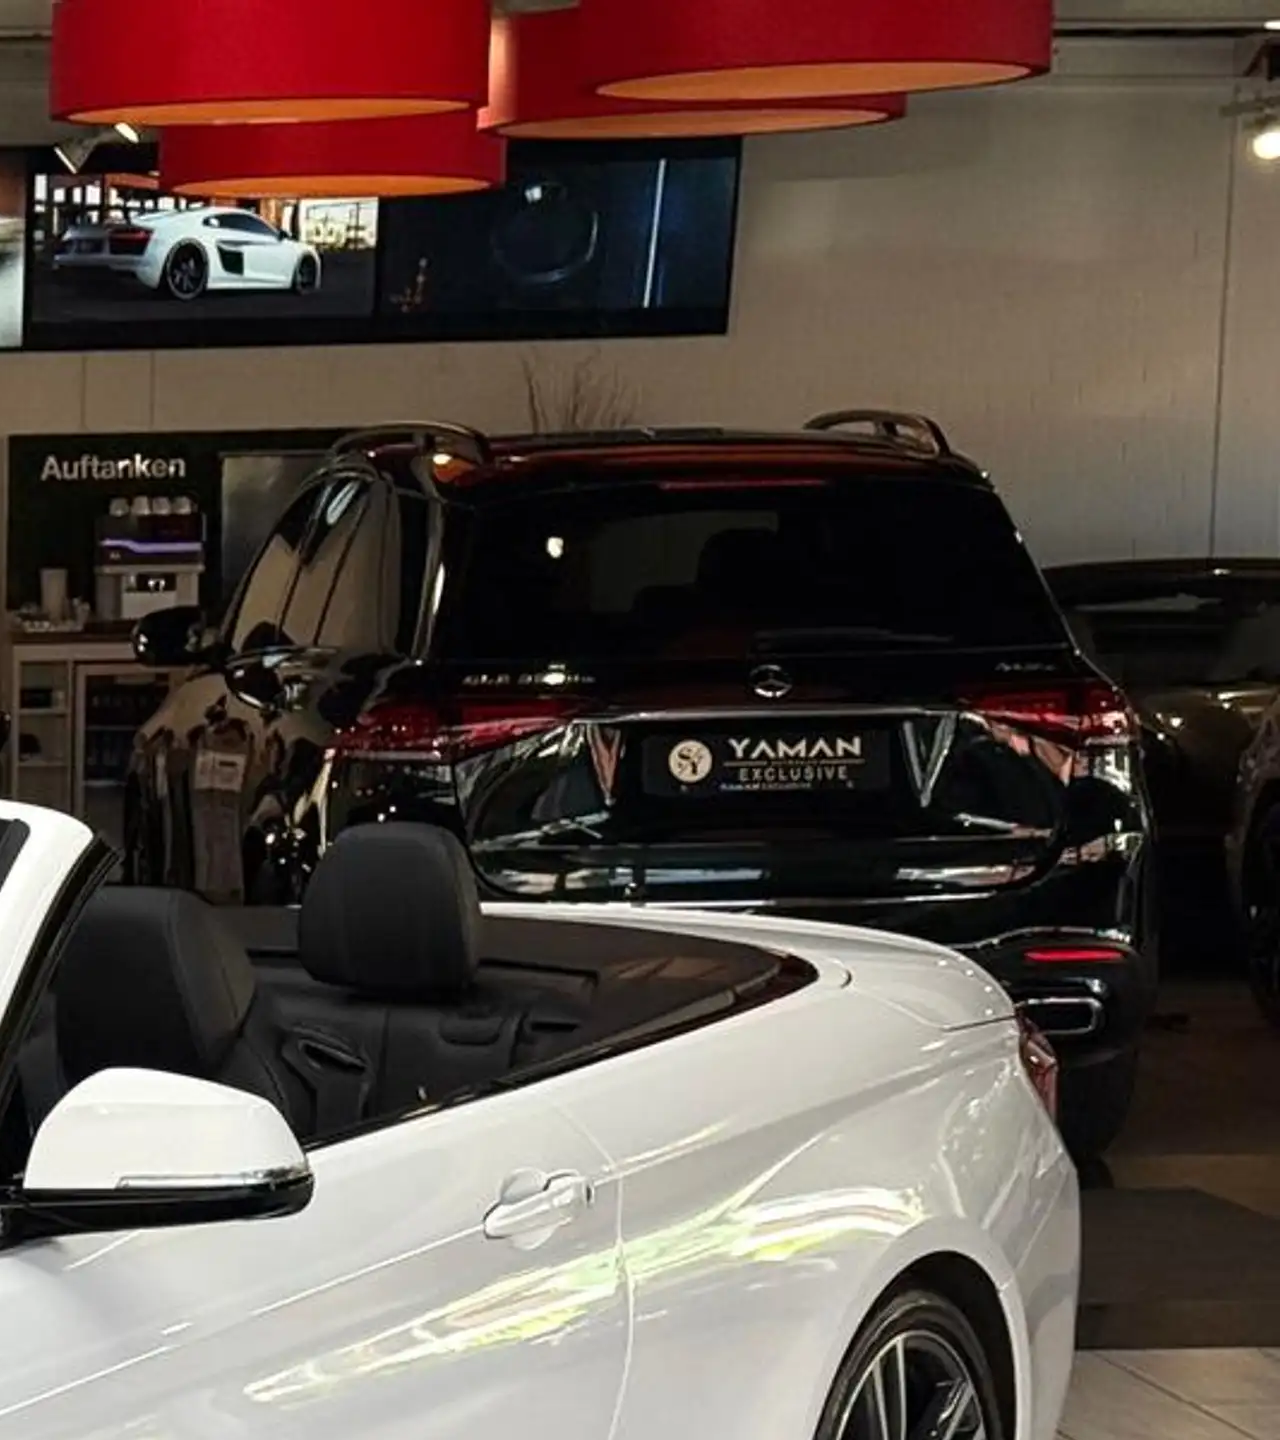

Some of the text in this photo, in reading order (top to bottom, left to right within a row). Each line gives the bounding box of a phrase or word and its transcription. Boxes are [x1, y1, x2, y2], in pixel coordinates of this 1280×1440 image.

[41, 453, 185, 481] Auftanken
[727, 736, 862, 759] YAMAN
[739, 766, 848, 782] EXCLUSIVE
